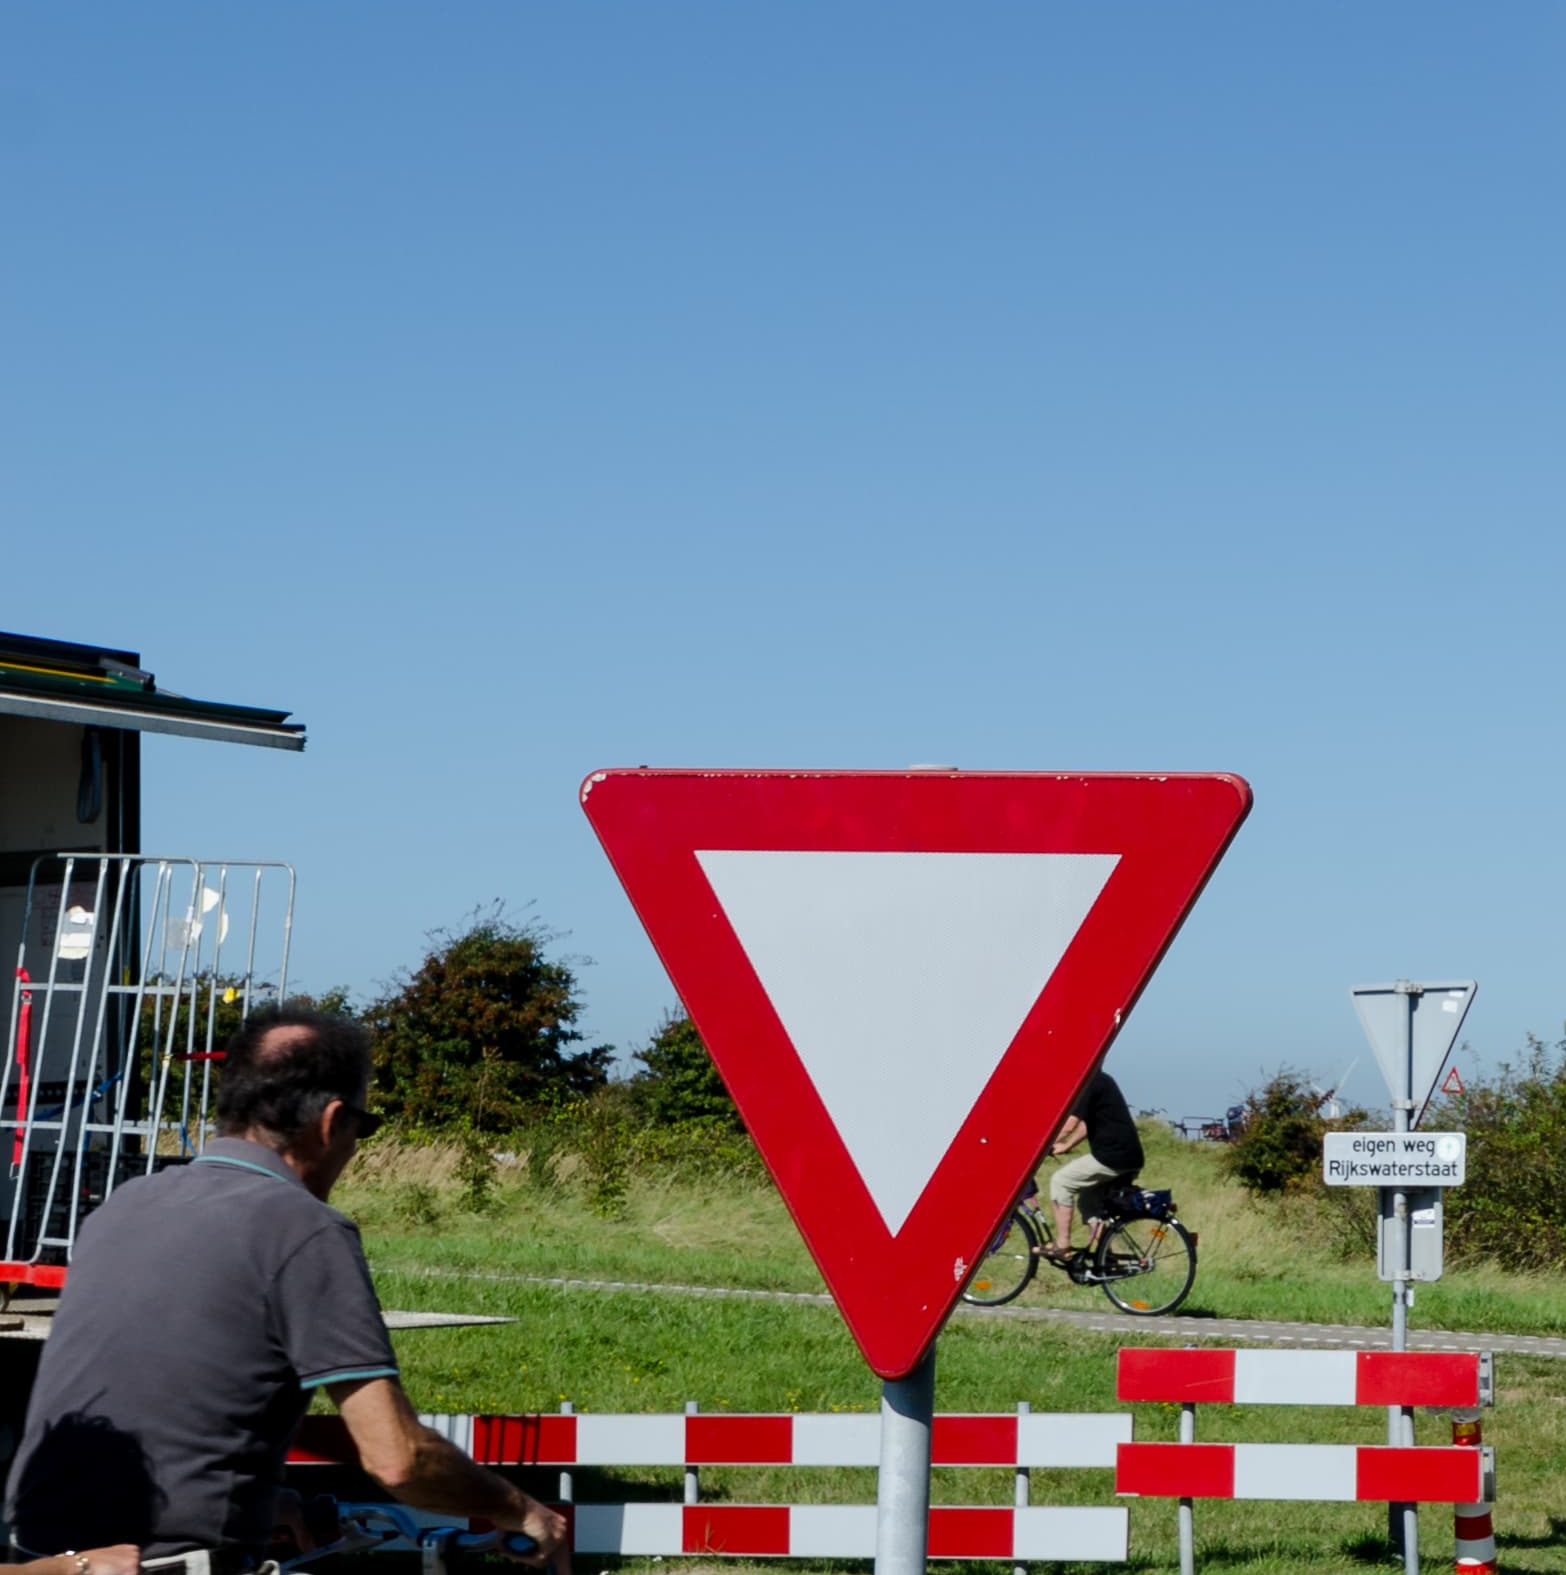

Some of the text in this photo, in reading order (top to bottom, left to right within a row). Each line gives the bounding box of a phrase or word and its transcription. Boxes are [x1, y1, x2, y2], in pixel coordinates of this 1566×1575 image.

[1352, 1137, 1435, 1157] eigen weg
[1329, 1160, 1458, 1181] Rijkswaterstaat
